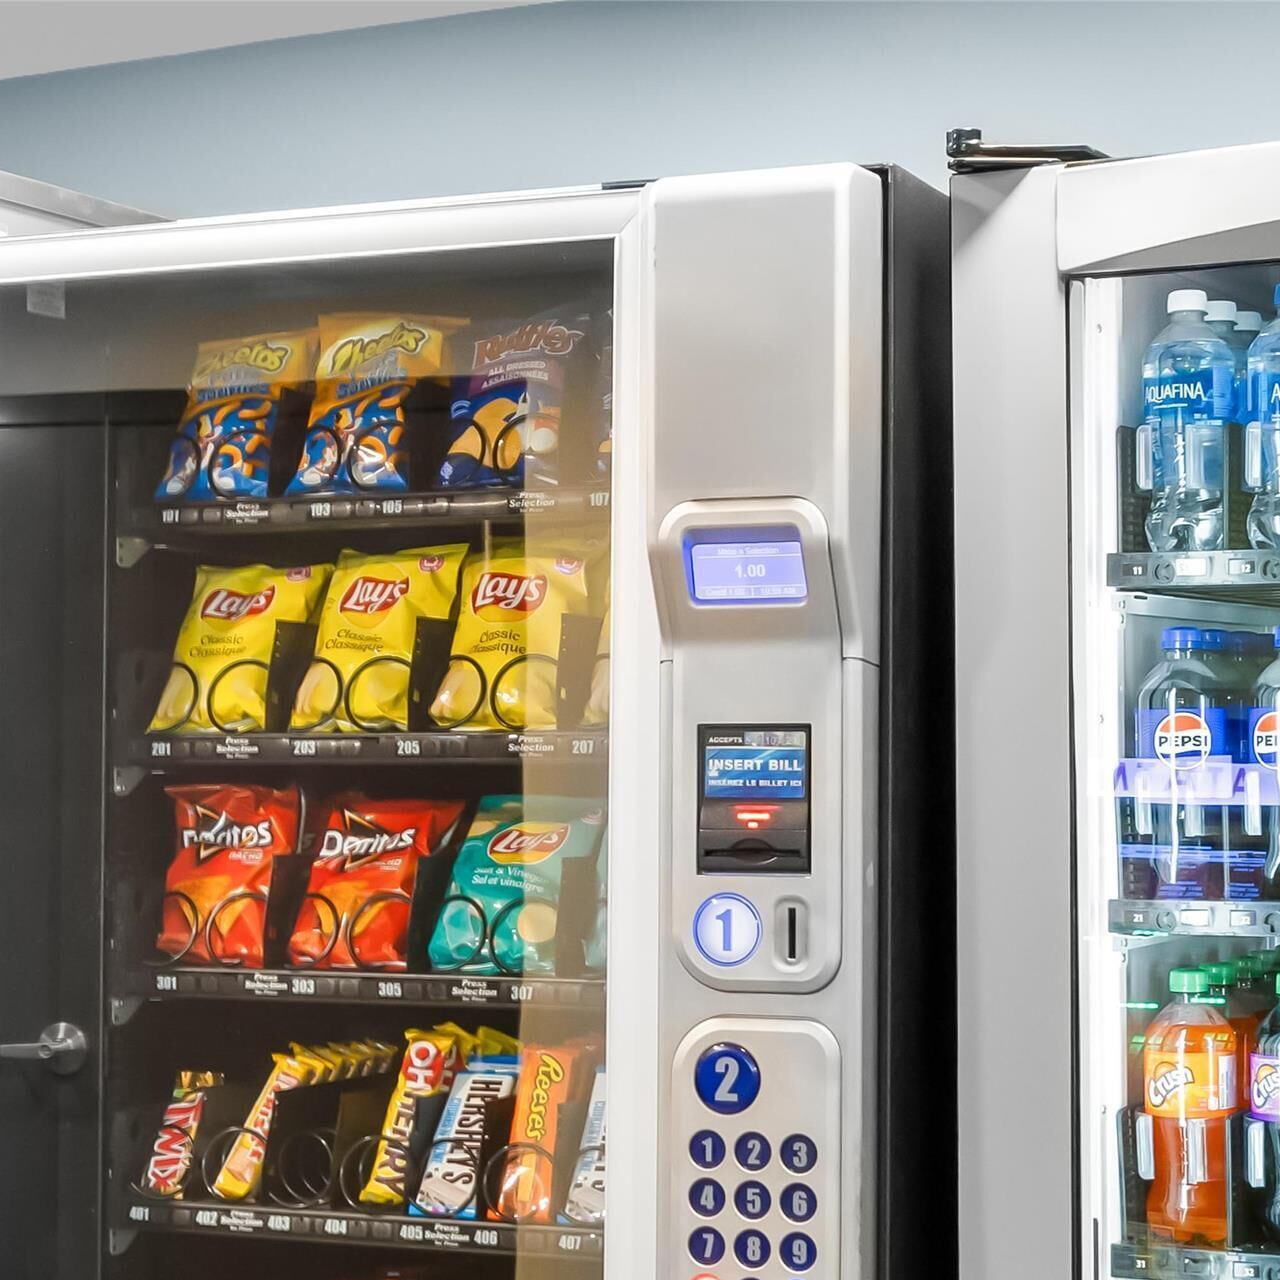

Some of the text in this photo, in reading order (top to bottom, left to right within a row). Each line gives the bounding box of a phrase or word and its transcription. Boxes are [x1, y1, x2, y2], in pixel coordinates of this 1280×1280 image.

[330, 322, 429, 374] Cheetos
[472, 320, 585, 369] Ruffles
[1146, 380, 1206, 403] AQUAFINA
[310, 503, 330, 517] 103
[382, 501, 402, 514] 105
[509, 499, 555, 508] Selection
[162, 510, 179, 523] 101
[734, 564, 766, 578] 1.00
[341, 577, 408, 613] Lay's
[475, 573, 544, 609] Lay's
[480, 629, 521, 643] Classic
[294, 740, 316, 755] 203
[397, 740, 420, 755] 205
[508, 743, 554, 752] Selection
[572, 740, 593, 754] 207
[708, 736, 743, 744] ACCEPTS
[1158, 735, 1208, 748] PEPSI
[151, 742, 171, 756] 201
[708, 758, 802, 772] INSERT BILL
[759, 779, 788, 787] BILLET
[790, 779, 802, 787] ICI
[320, 828, 416, 858] Doritos
[715, 908, 733, 951] 1
[156, 976, 177, 989] 301
[292, 979, 315, 994] 303
[378, 982, 402, 997] 305
[511, 985, 534, 1000] 307
[714, 1056, 740, 1102] 2
[1149, 1066, 1193, 1107] Crush
[525, 1053, 564, 1141] Reese's
[701, 1137, 713, 1162] 1
[746, 1139, 761, 1165] 2
[792, 1141, 808, 1168] 3
[700, 1185, 715, 1210] 4
[746, 1187, 761, 1213] 5
[792, 1190, 808, 1217] 6
[129, 1206, 150, 1221] 401
[195, 1211, 218, 1226] 402
[268, 1216, 291, 1231] 403
[324, 1219, 347, 1235] 404
[400, 1224, 423, 1241] 405
[474, 1230, 498, 1246] 406
[558, 1235, 581, 1250] 407
[702, 1233, 715, 1258] 7
[746, 1236, 761, 1261] 8
[792, 1239, 808, 1265] 9
[1136, 1260, 1146, 1268] 31
